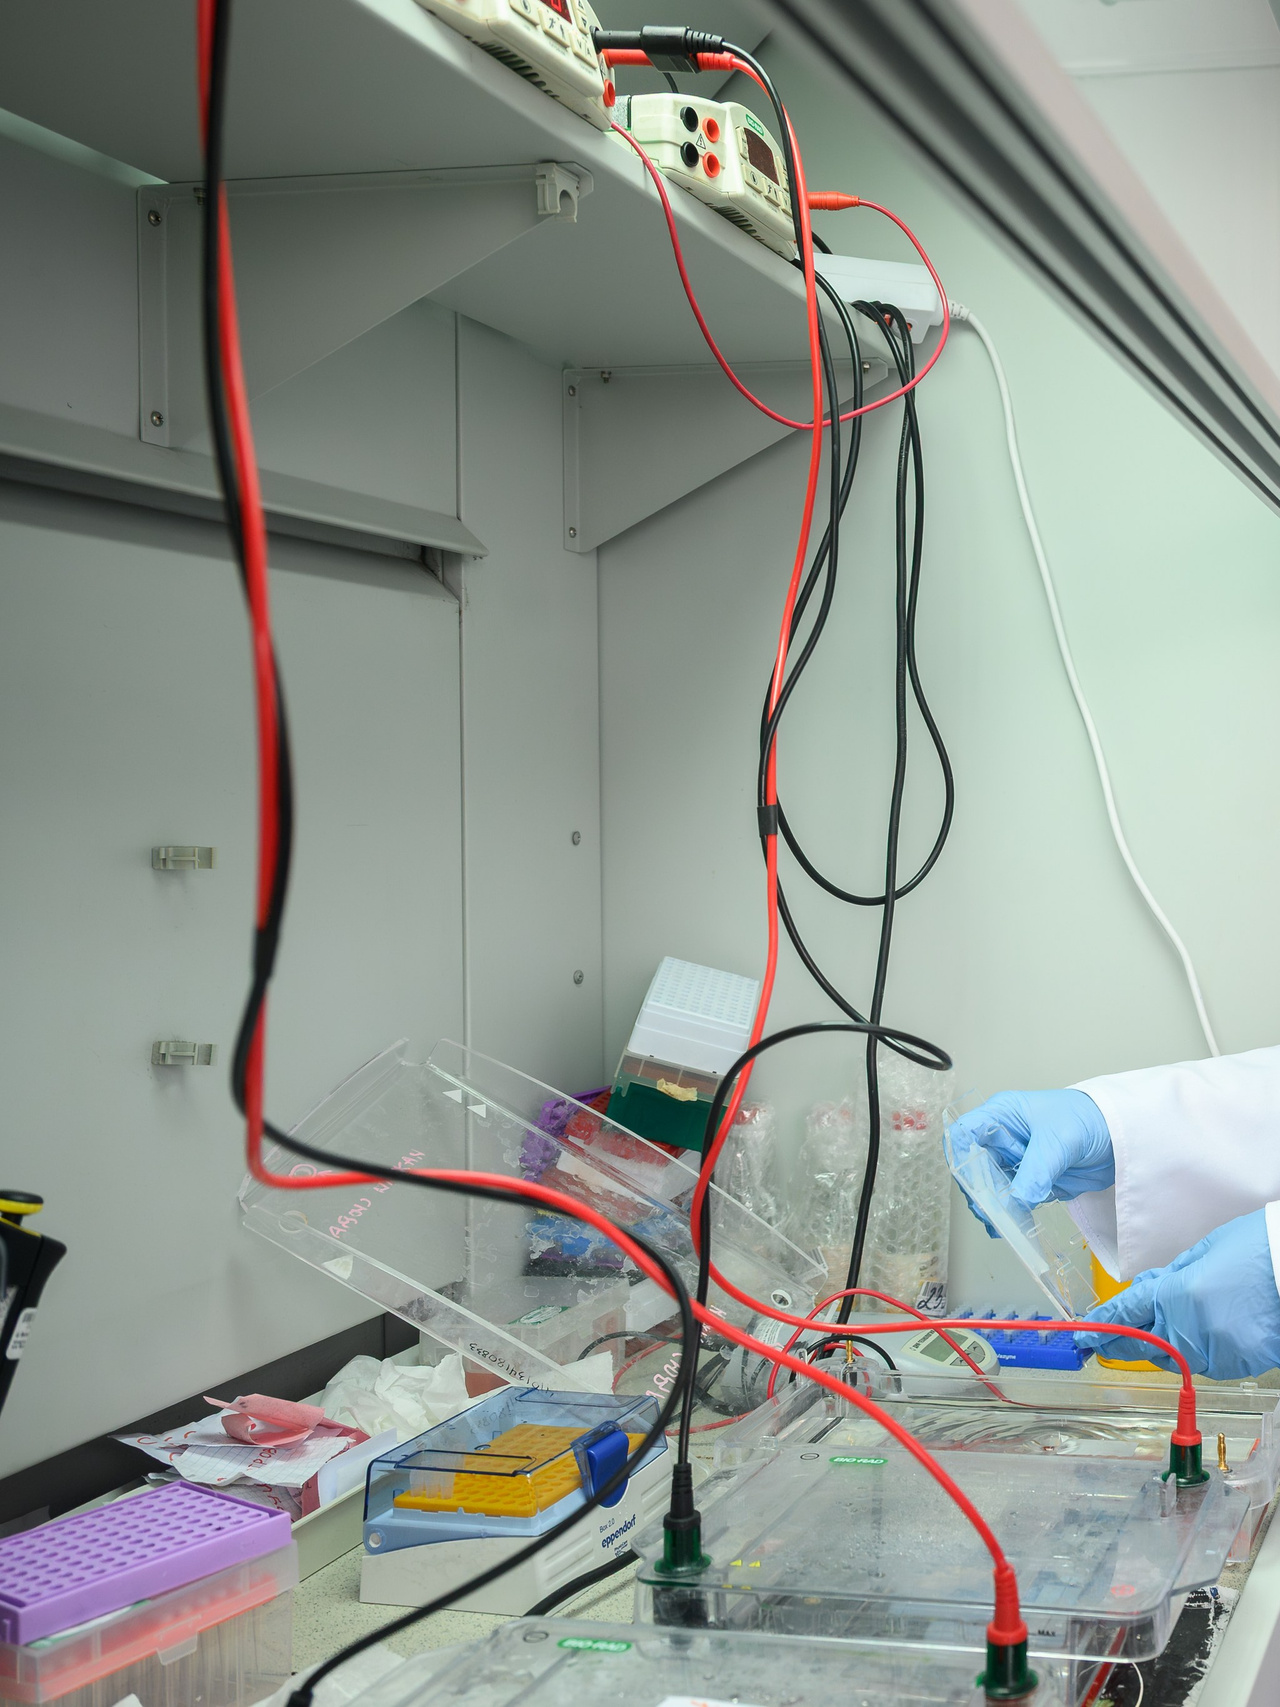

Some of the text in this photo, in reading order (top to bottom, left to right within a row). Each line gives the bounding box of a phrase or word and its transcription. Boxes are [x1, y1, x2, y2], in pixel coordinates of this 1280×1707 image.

[833, 1456, 884, 1464] BIO-RAD
[601, 1513, 636, 1549] eppendorf
[561, 1638, 628, 1652] BIO-RAD
